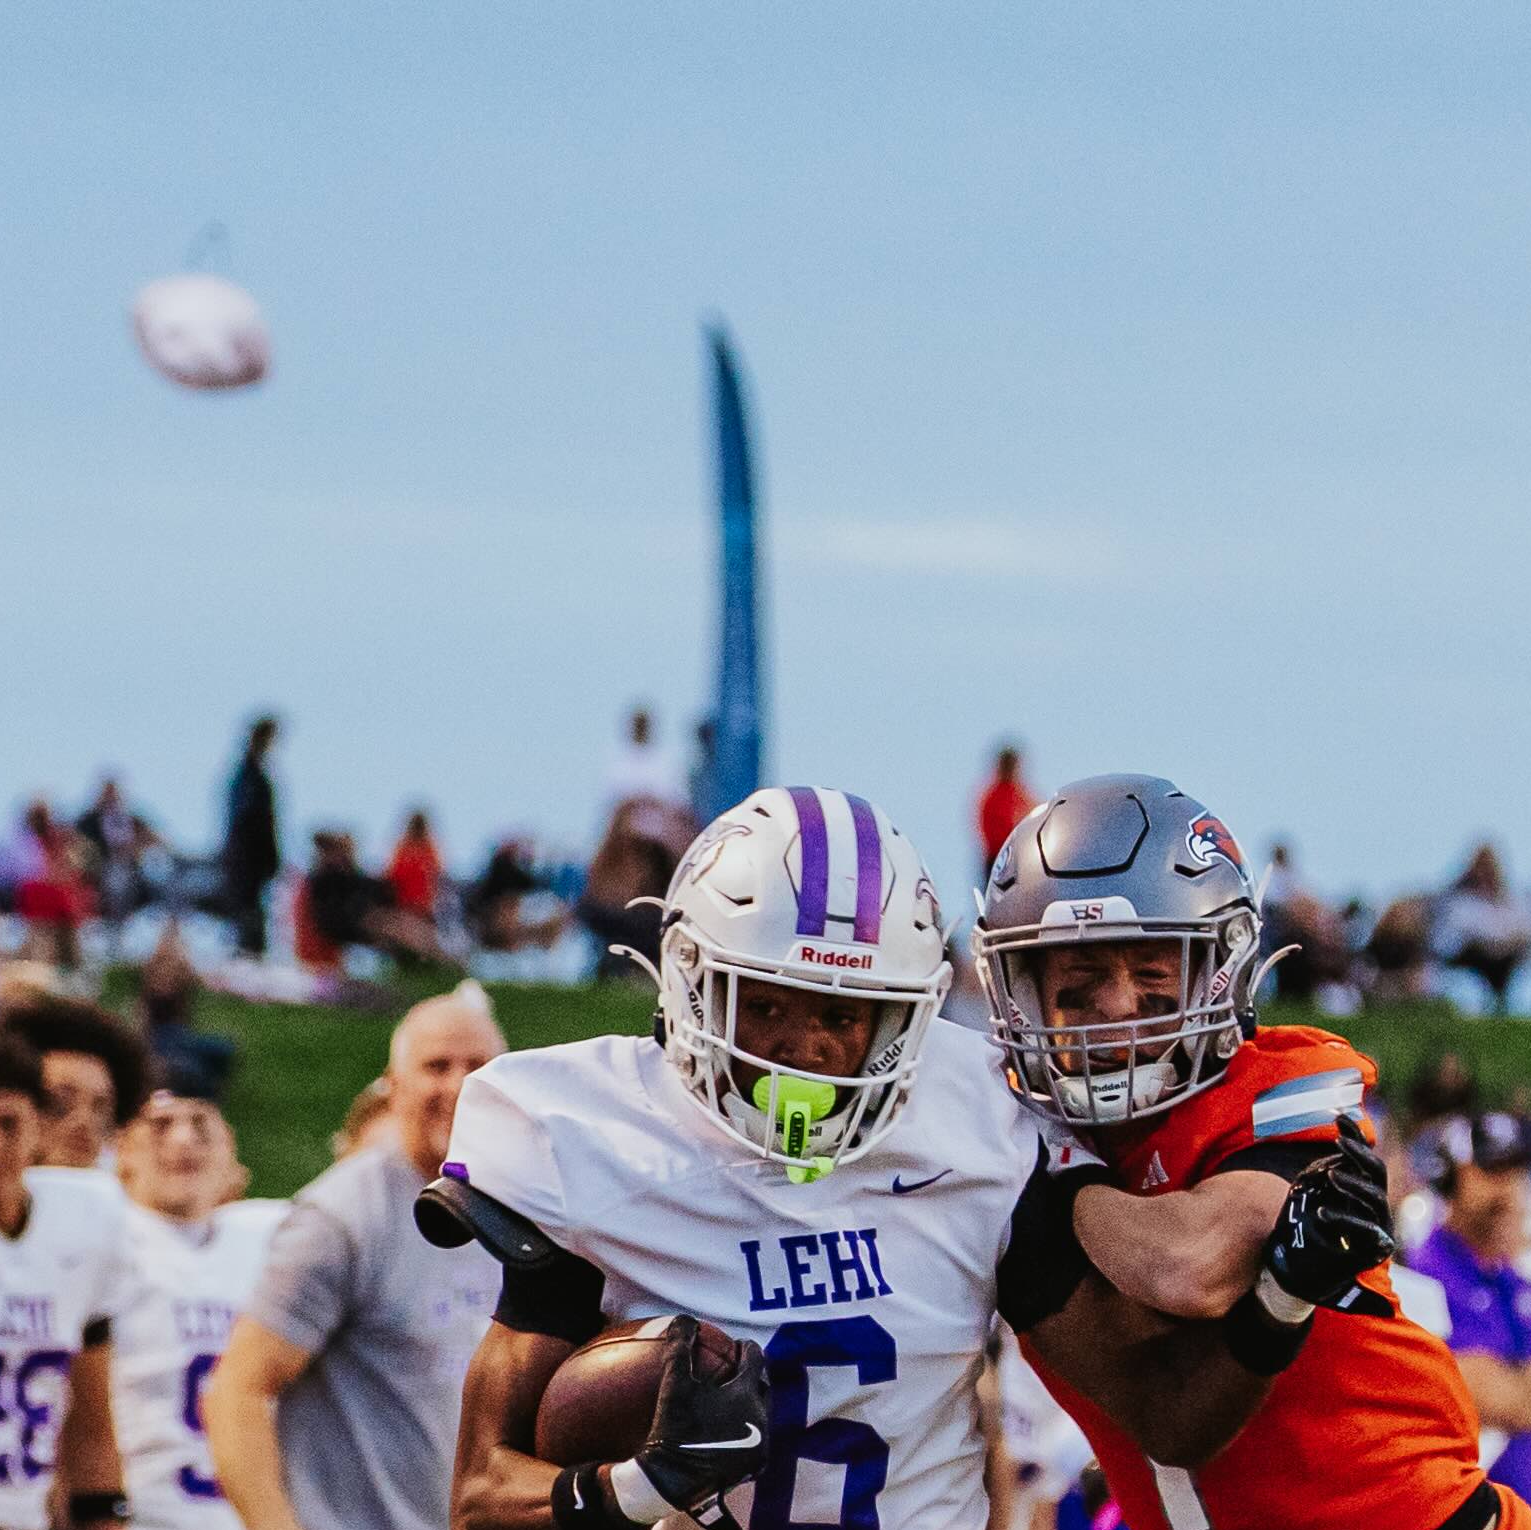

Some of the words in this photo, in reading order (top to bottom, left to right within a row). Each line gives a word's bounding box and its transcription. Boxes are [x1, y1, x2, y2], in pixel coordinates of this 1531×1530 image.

[801, 946, 873, 970] Riddell
[867, 1039, 907, 1077] Ridd
[739, 1228, 894, 1312] LEHI
